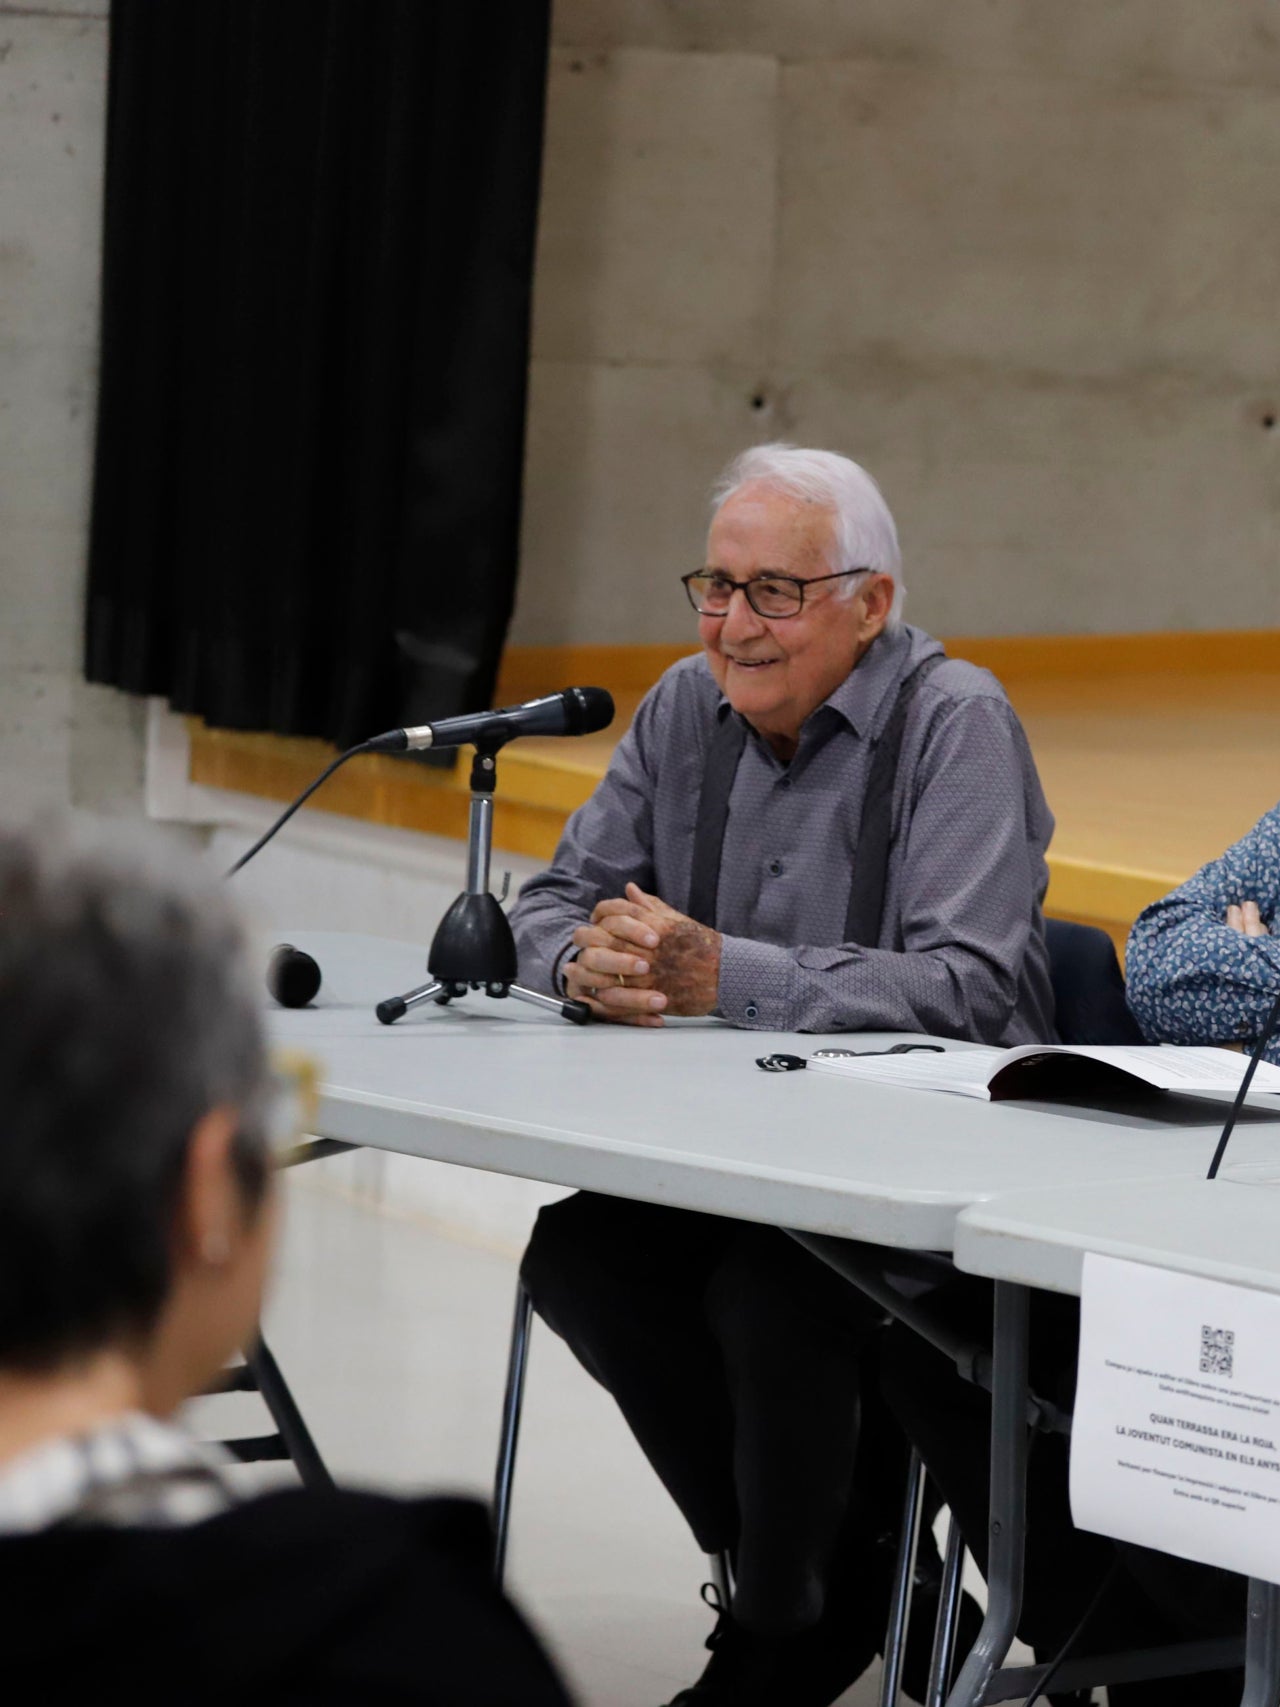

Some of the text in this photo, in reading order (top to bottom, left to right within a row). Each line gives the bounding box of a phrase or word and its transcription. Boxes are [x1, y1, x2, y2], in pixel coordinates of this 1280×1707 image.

[1149, 1413, 1174, 1426] QUAN
[1176, 1419, 1219, 1437] TERRASSA
[1221, 1429, 1238, 1441] ERA
[1240, 1434, 1251, 1444] LA
[1115, 1425, 1126, 1435] LA
[1127, 1428, 1171, 1446] JOVENTUT
[1172, 1438, 1223, 1458] COMUNISTA
[1225, 1451, 1237, 1461] EN
[1239, 1455, 1255, 1466] ELS
[1256, 1460, 1280, 1472] ANYS
